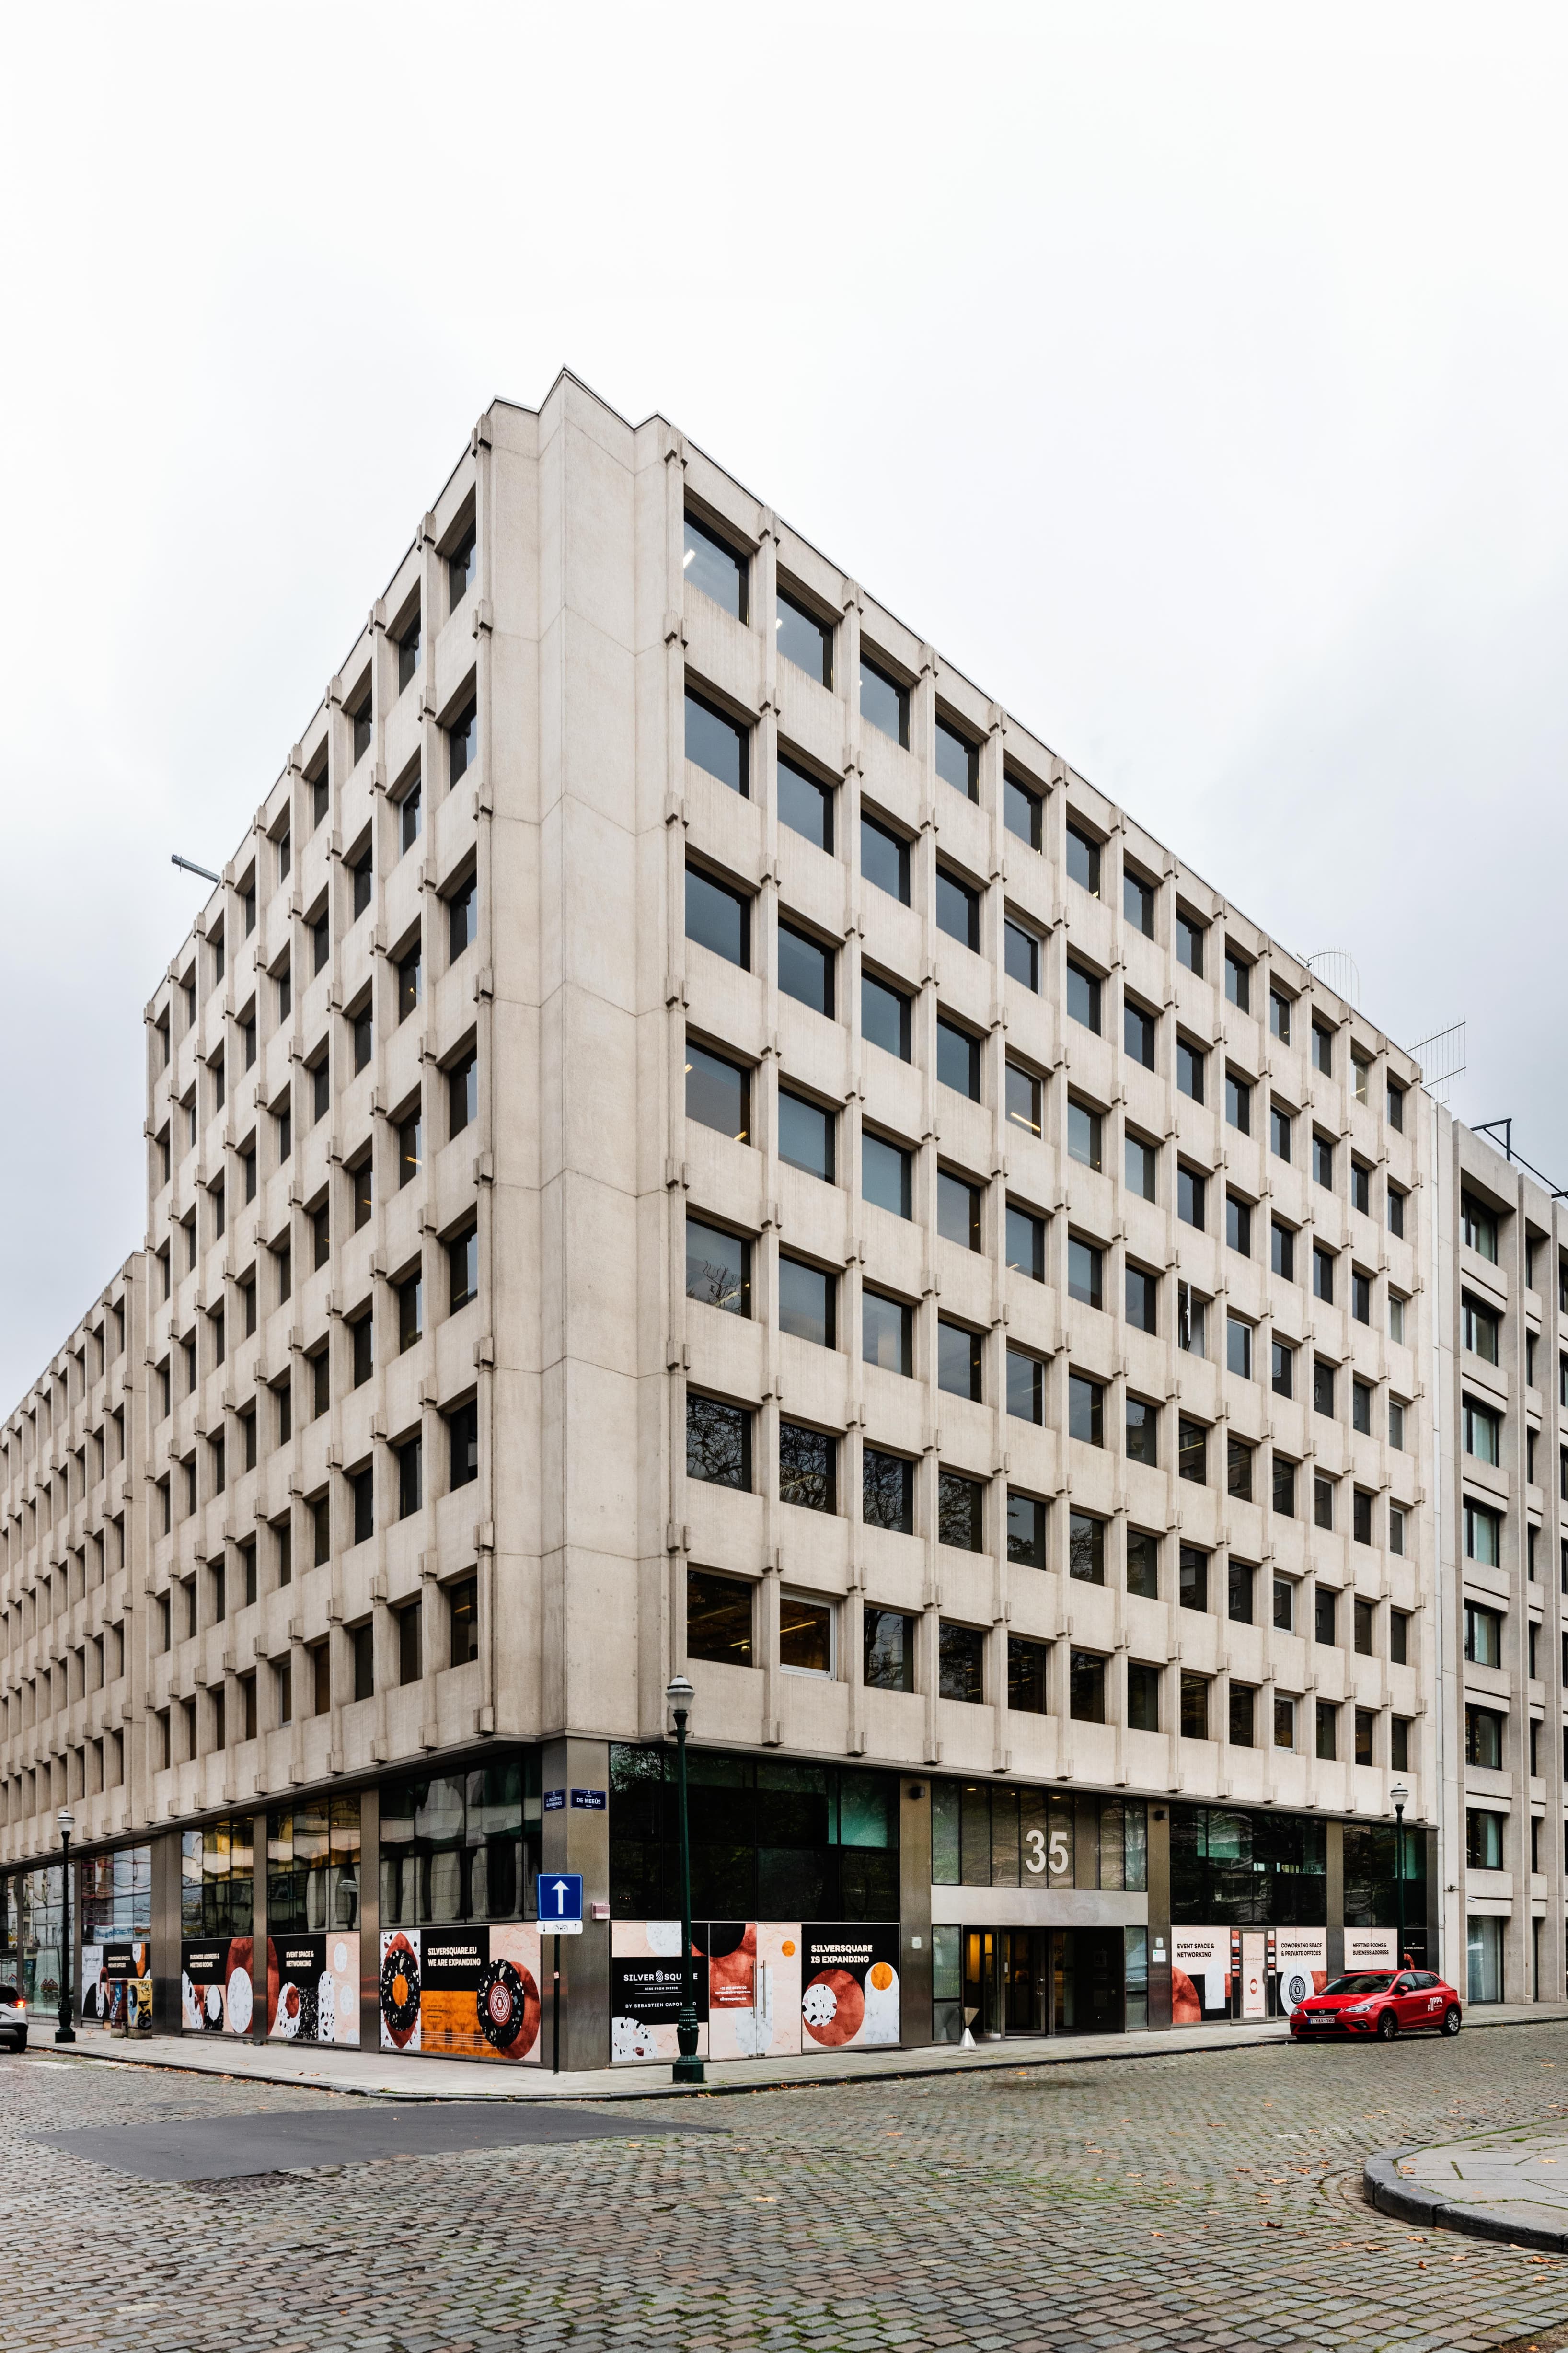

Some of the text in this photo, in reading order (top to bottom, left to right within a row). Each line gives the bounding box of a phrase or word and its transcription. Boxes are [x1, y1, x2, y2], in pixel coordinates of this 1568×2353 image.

[1026, 1830, 1068, 1874] 35
[428, 1947, 477, 1956] SILVERSQUARE.EU
[811, 1945, 873, 1954] SILVERSQUARE
[449, 1958, 481, 1966] EXPANDING
